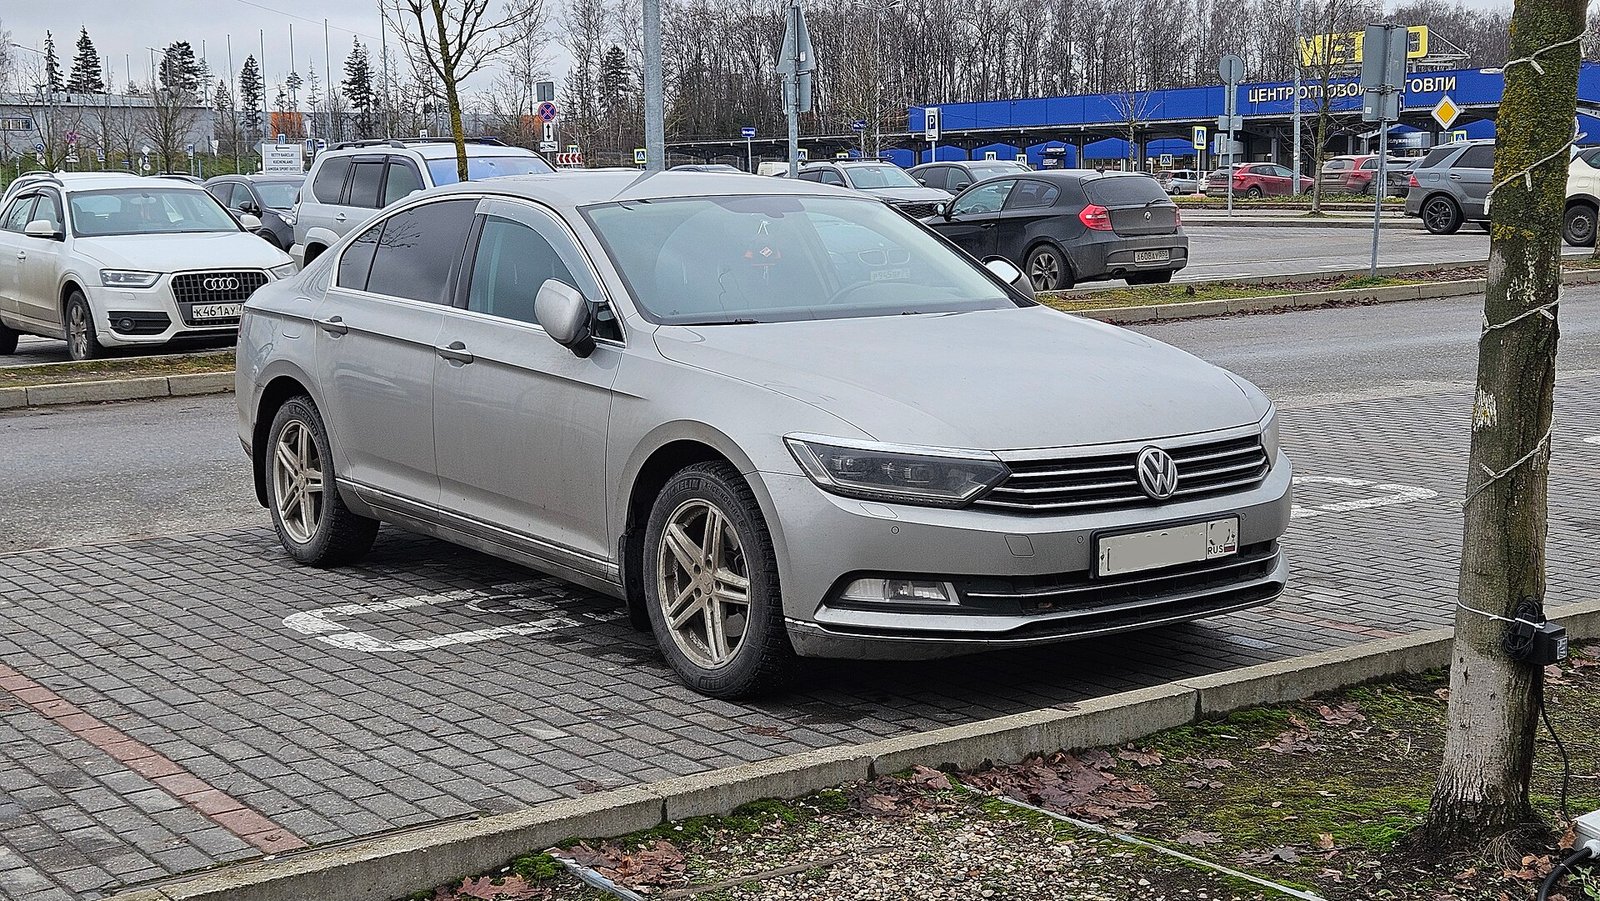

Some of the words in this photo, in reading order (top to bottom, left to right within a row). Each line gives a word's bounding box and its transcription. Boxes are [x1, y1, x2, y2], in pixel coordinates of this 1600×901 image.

[1299, 25, 1428, 67] METO
[1248, 86, 1295, 104] ЦЕНТР
[1403, 76, 1456, 93] ГОВЛИ
[1207, 545, 1223, 555] RUS
